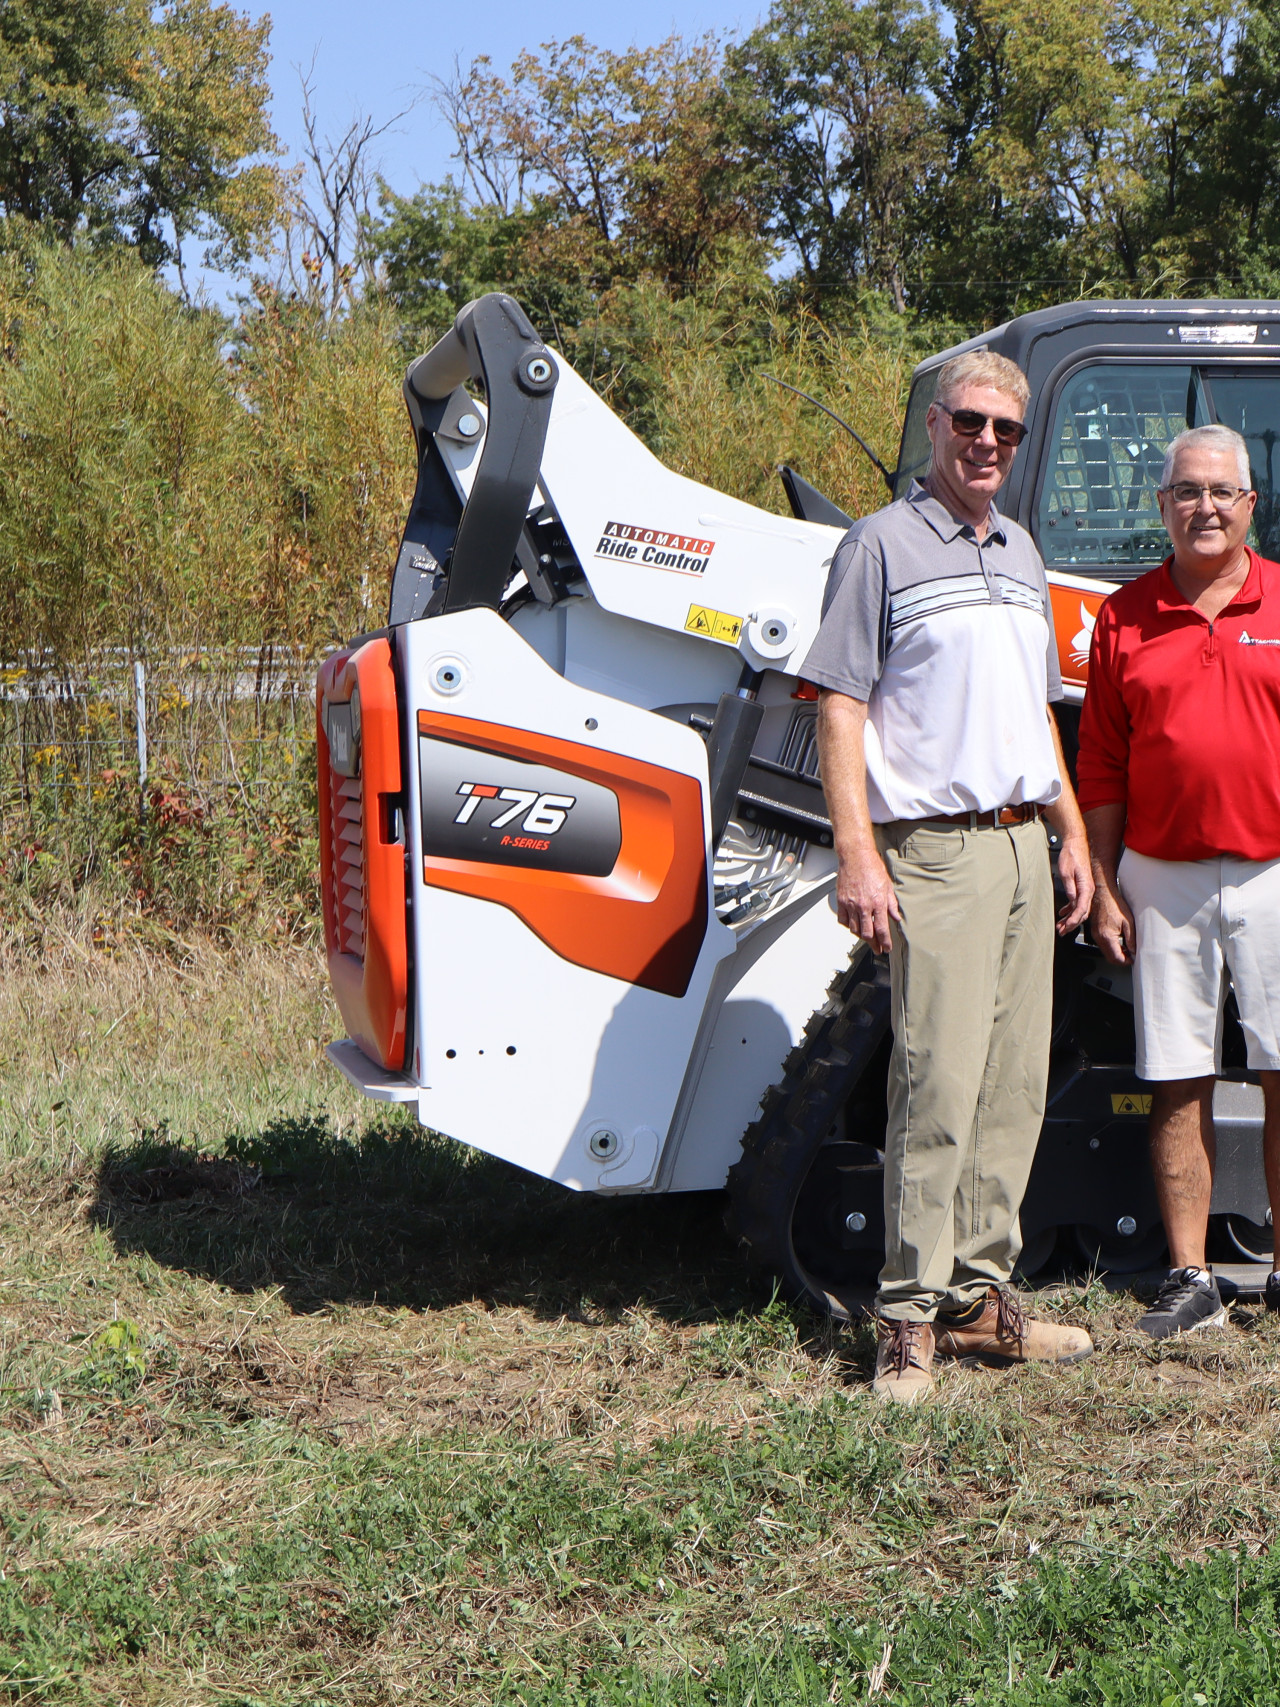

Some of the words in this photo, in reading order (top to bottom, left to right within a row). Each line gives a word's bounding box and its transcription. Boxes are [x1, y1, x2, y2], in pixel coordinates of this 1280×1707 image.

[595, 537, 638, 559] Ride
[641, 546, 709, 573] Control
[607, 523, 711, 554] AUTOMATIC
[454, 781, 576, 835] T76
[500, 835, 551, 851] R-SERIES
